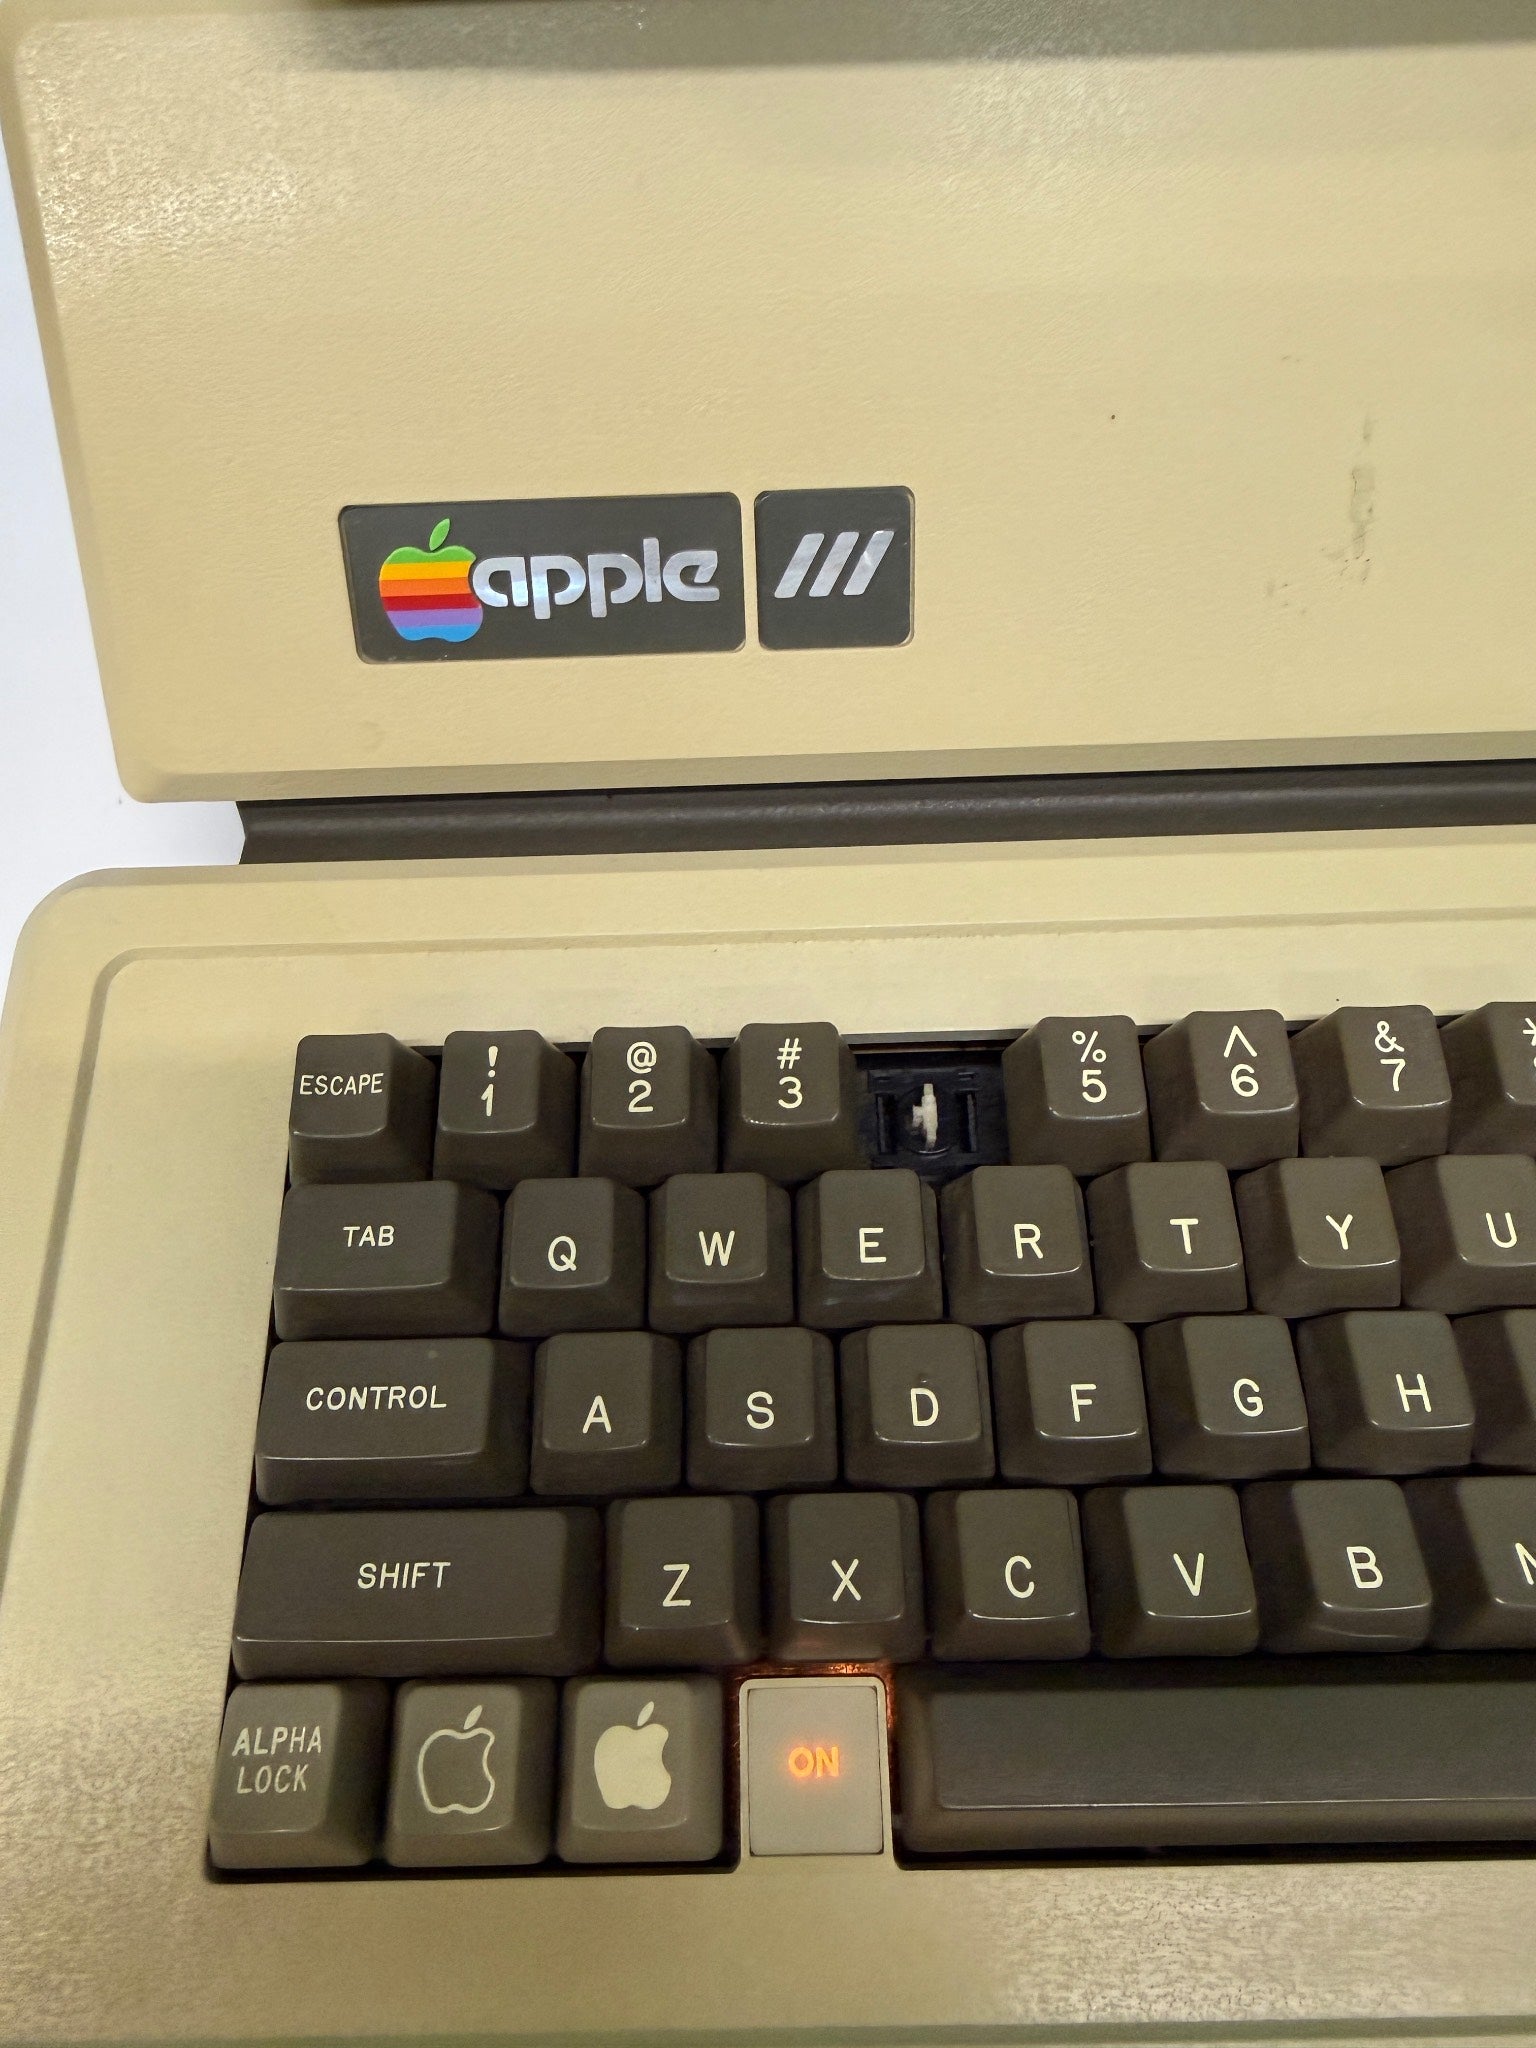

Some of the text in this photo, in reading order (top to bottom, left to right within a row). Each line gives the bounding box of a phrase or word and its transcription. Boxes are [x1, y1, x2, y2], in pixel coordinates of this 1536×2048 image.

[471, 537, 720, 620] apple
[776, 1037, 803, 1070] #
[1071, 1030, 1107, 1063] %
[1374, 1020, 1405, 1053] &
[487, 1045, 499, 1078] !
[626, 1041, 657, 1074] @
[1380, 1058, 1406, 1092] 7
[299, 1072, 384, 1096] ESCAPE
[628, 1079, 654, 1113] 2
[778, 1076, 803, 1109] 3
[1081, 1069, 1107, 1104] 5
[1230, 1063, 1259, 1098] 6
[480, 1083, 494, 1117] 1
[342, 1225, 395, 1248] TAB
[698, 1230, 736, 1267] W
[858, 1227, 887, 1264] E
[1013, 1223, 1044, 1259] R
[1169, 1218, 1199, 1255] T
[1325, 1213, 1354, 1251] Y
[1485, 1212, 1518, 1249] U
[547, 1235, 577, 1272] Q
[306, 1384, 447, 1411] CONTROL
[746, 1390, 775, 1430] S
[910, 1387, 939, 1427] D
[1070, 1383, 1097, 1423] F
[1233, 1378, 1264, 1418] G
[1395, 1373, 1432, 1413] H
[582, 1395, 612, 1434] A
[357, 1561, 451, 1590] SHIFT
[662, 1563, 692, 1607] Z
[831, 1558, 862, 1602] X
[1004, 1555, 1035, 1599] C
[1173, 1552, 1205, 1597] V
[1346, 1545, 1384, 1589] B
[231, 1725, 322, 1757] ALPHA
[236, 1763, 309, 1794] LOCK
[787, 1744, 841, 1780] ON
